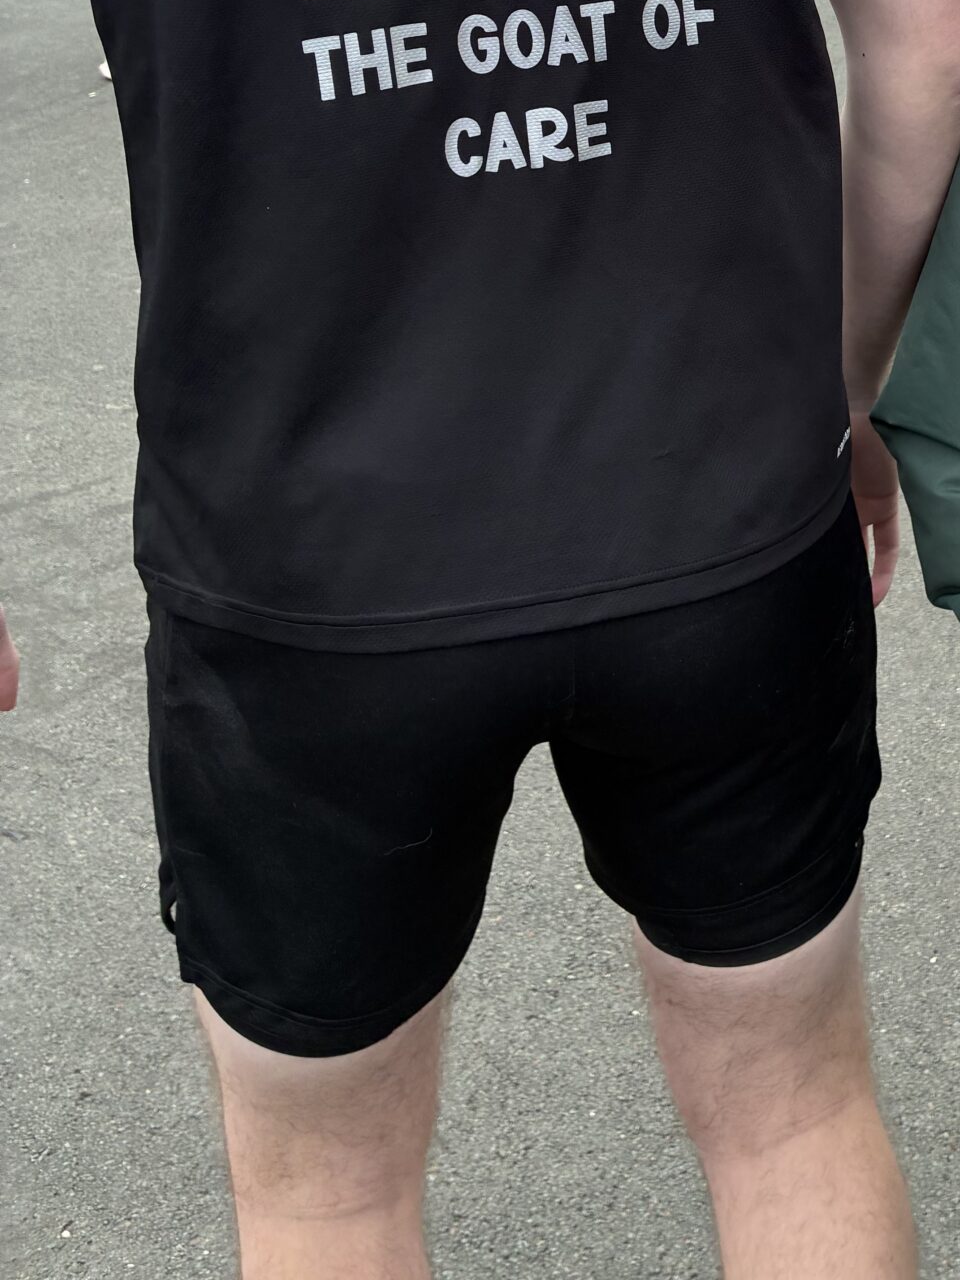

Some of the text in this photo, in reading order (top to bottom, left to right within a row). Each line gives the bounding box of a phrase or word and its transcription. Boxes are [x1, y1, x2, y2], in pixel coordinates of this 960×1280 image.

[302, 22, 434, 101] THE
[457, 0, 615, 74] GOAT
[444, 99, 612, 178] CARE
